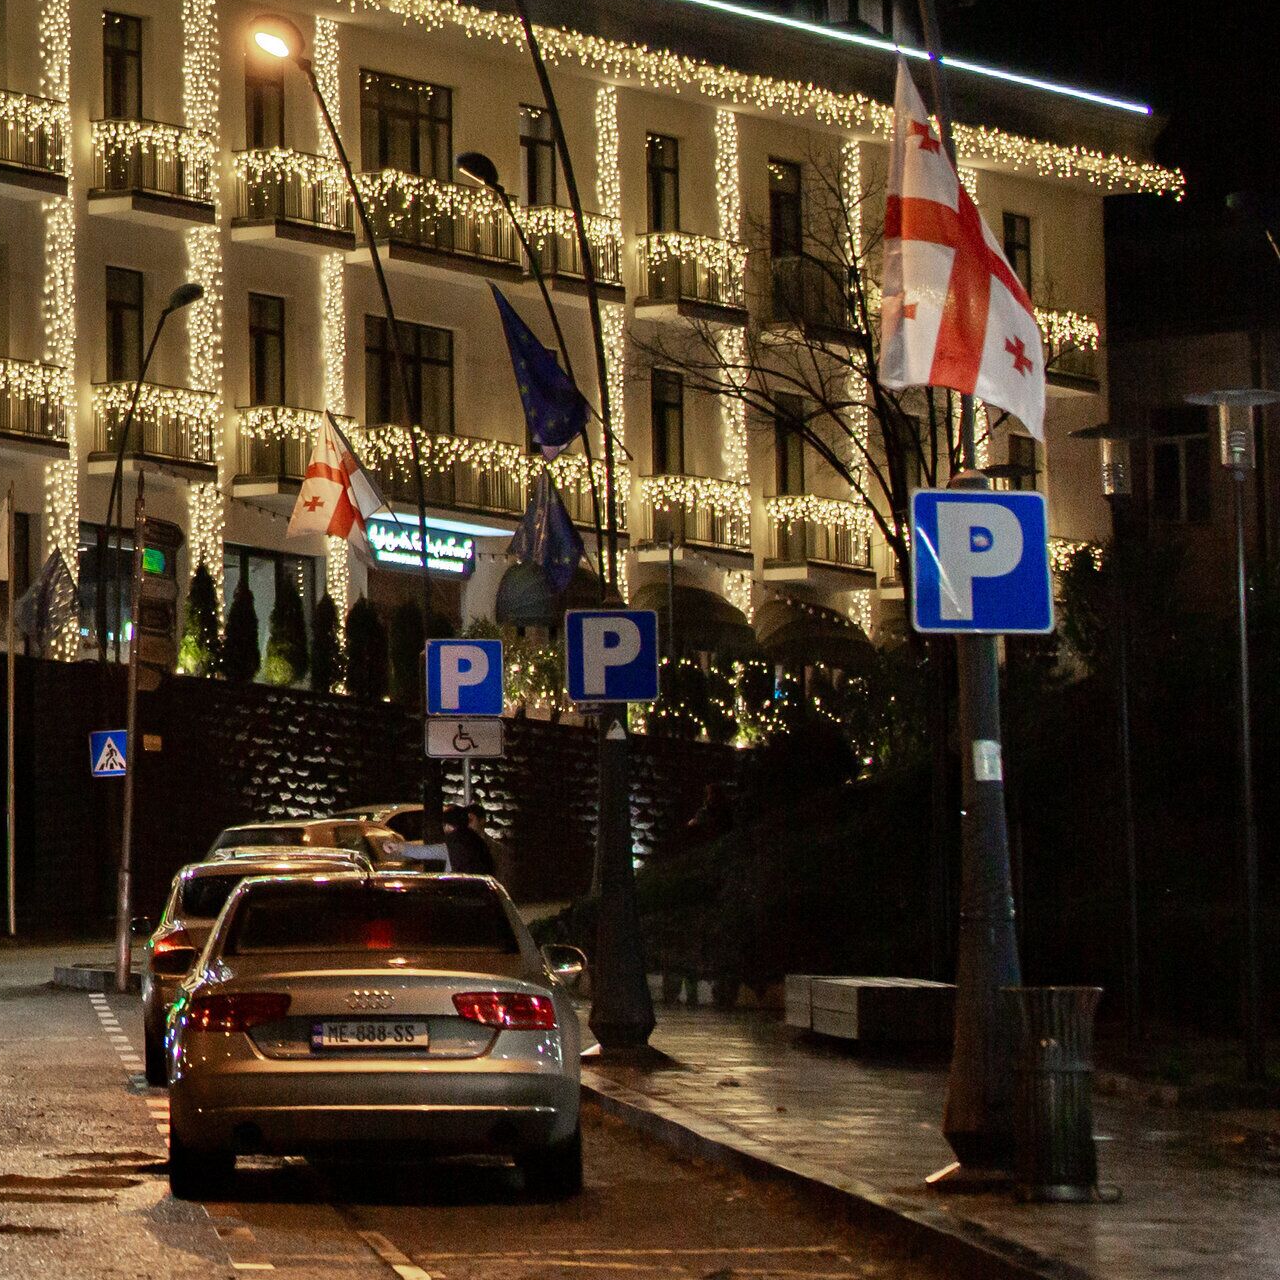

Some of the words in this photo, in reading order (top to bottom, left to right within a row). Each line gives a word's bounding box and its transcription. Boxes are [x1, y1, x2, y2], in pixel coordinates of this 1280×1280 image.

[936, 501, 1024, 621] P
[439, 645, 489, 709] P
[582, 617, 642, 695] P
[328, 1024, 415, 1043] ME-888-SS
